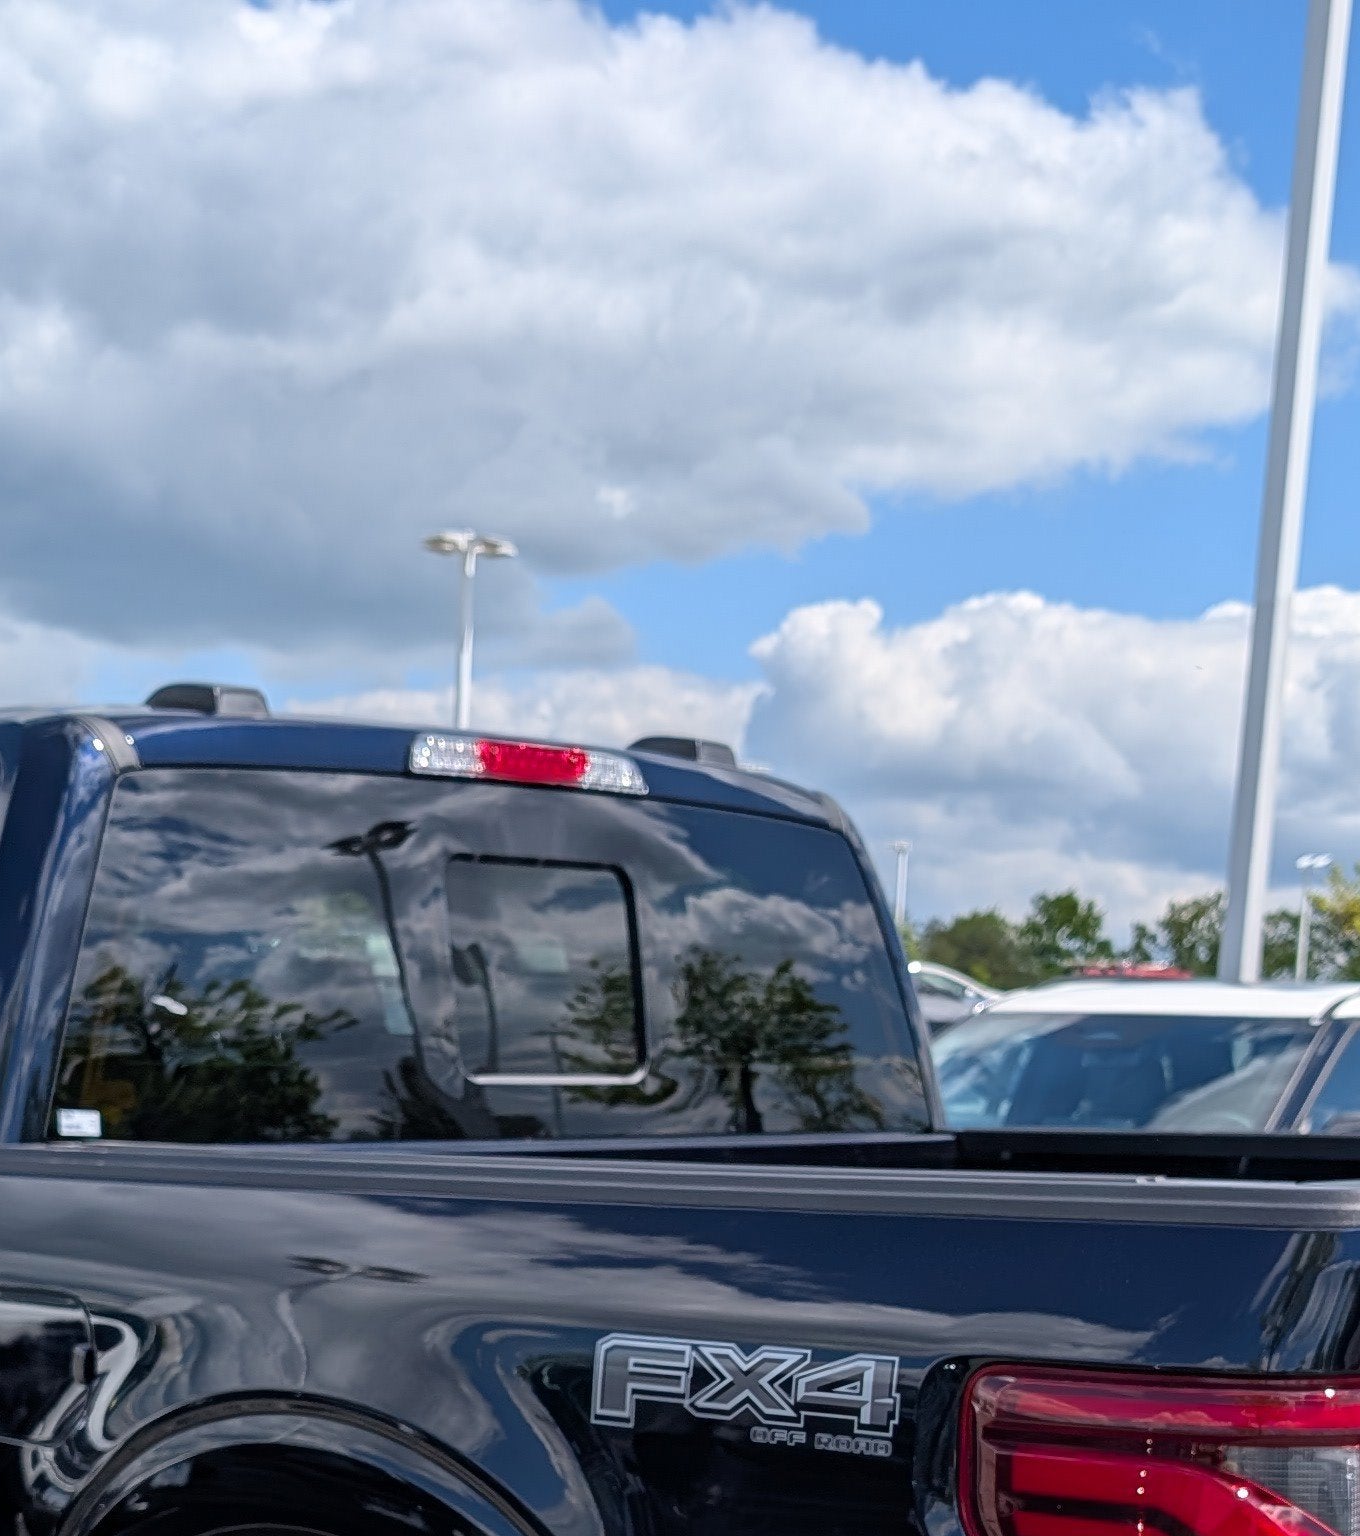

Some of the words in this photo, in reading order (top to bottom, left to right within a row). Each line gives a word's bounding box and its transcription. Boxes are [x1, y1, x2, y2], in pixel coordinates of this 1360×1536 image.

[590, 1333, 900, 1437] FX4
[749, 1426, 807, 1446] OFF
[814, 1432, 893, 1457] ROAD
